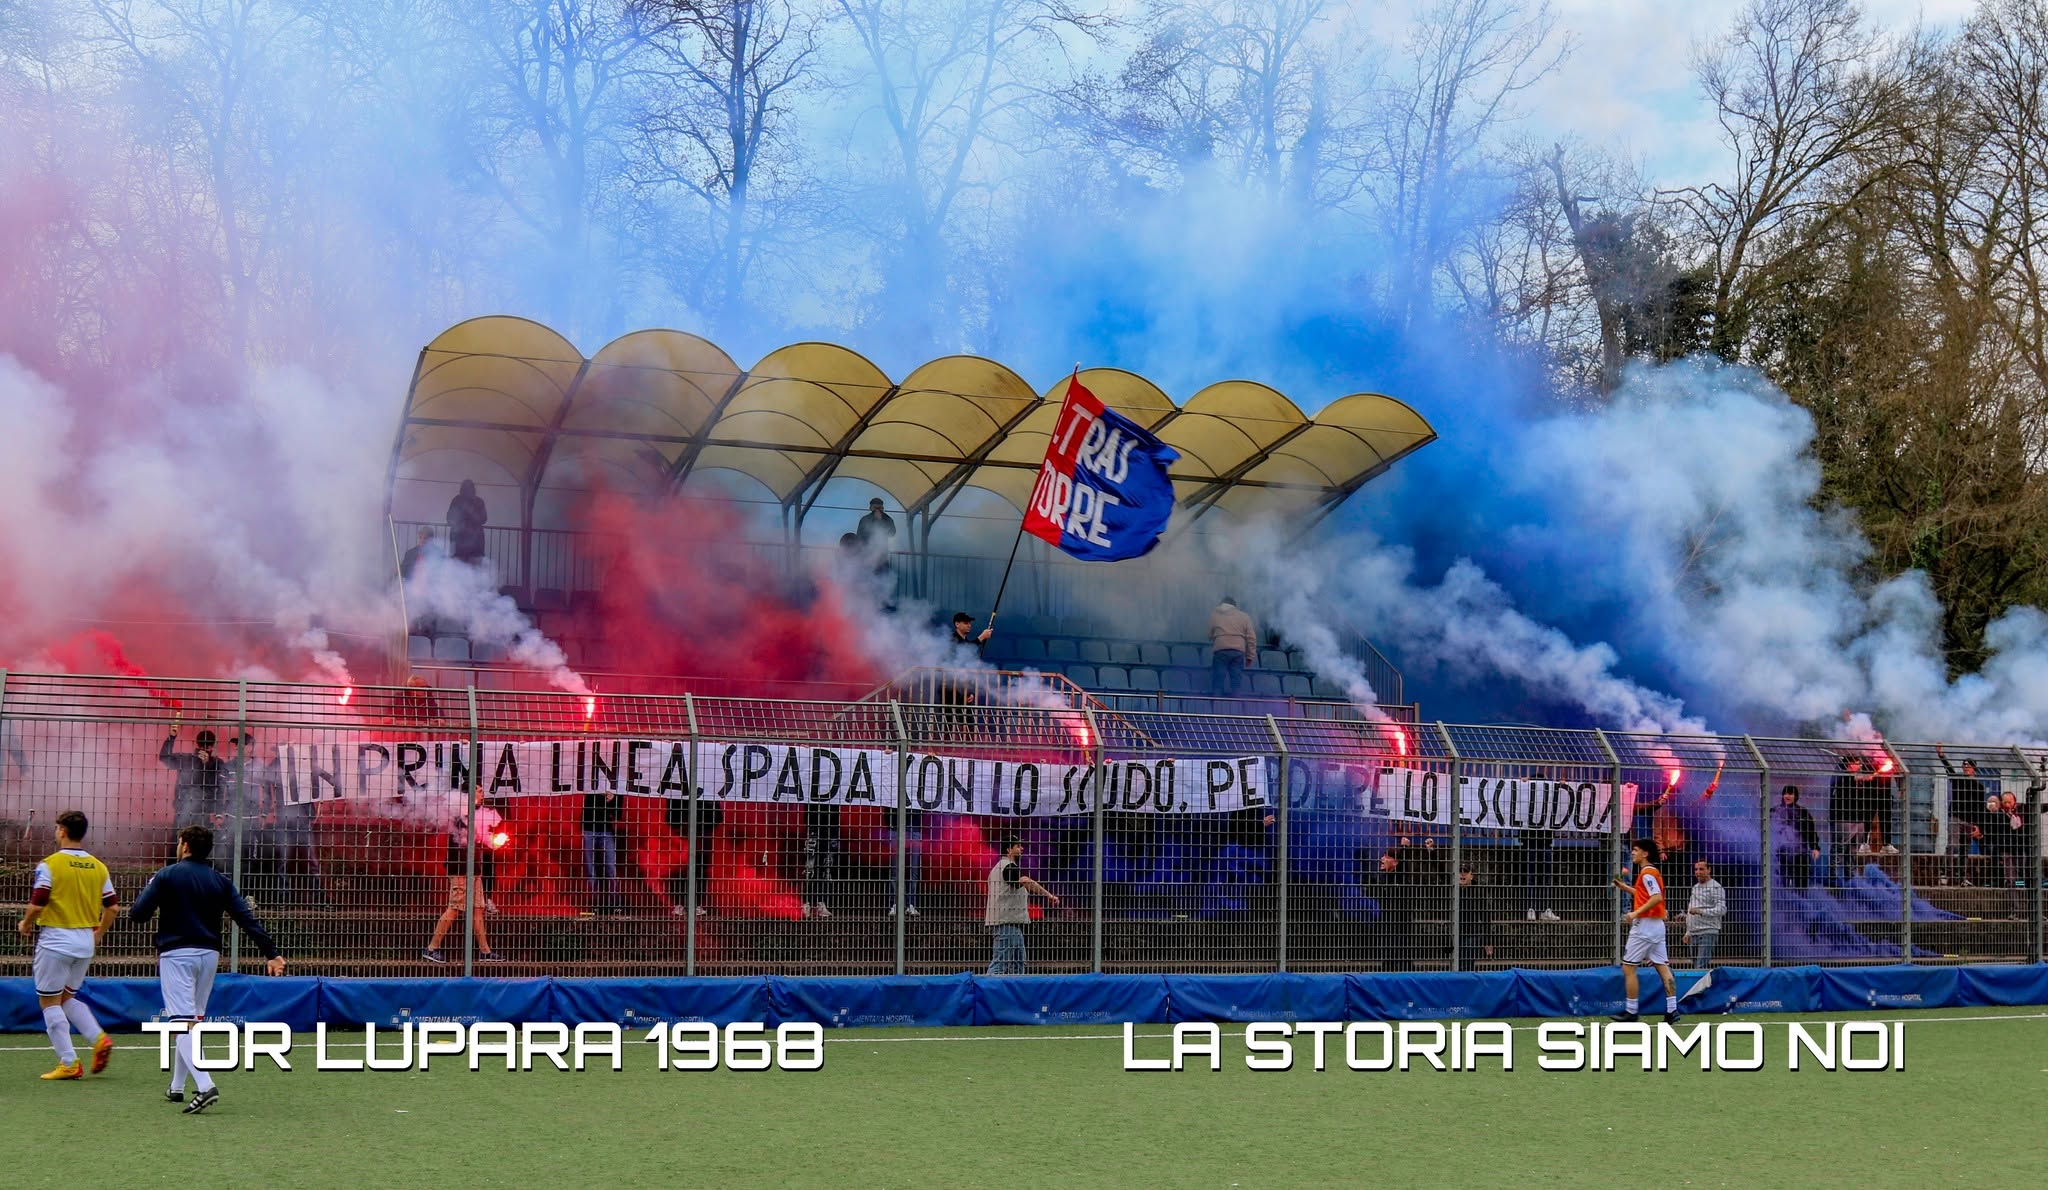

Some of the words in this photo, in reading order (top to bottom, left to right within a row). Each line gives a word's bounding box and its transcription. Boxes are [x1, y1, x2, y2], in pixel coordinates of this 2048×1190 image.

[287, 746, 342, 801] IN
[551, 741, 704, 799] LINEA,
[718, 743, 876, 802] SPADA
[992, 763, 1039, 816] LO
[1404, 770, 1438, 822] LO
[885, 1015, 915, 1024] HOSPITAL
